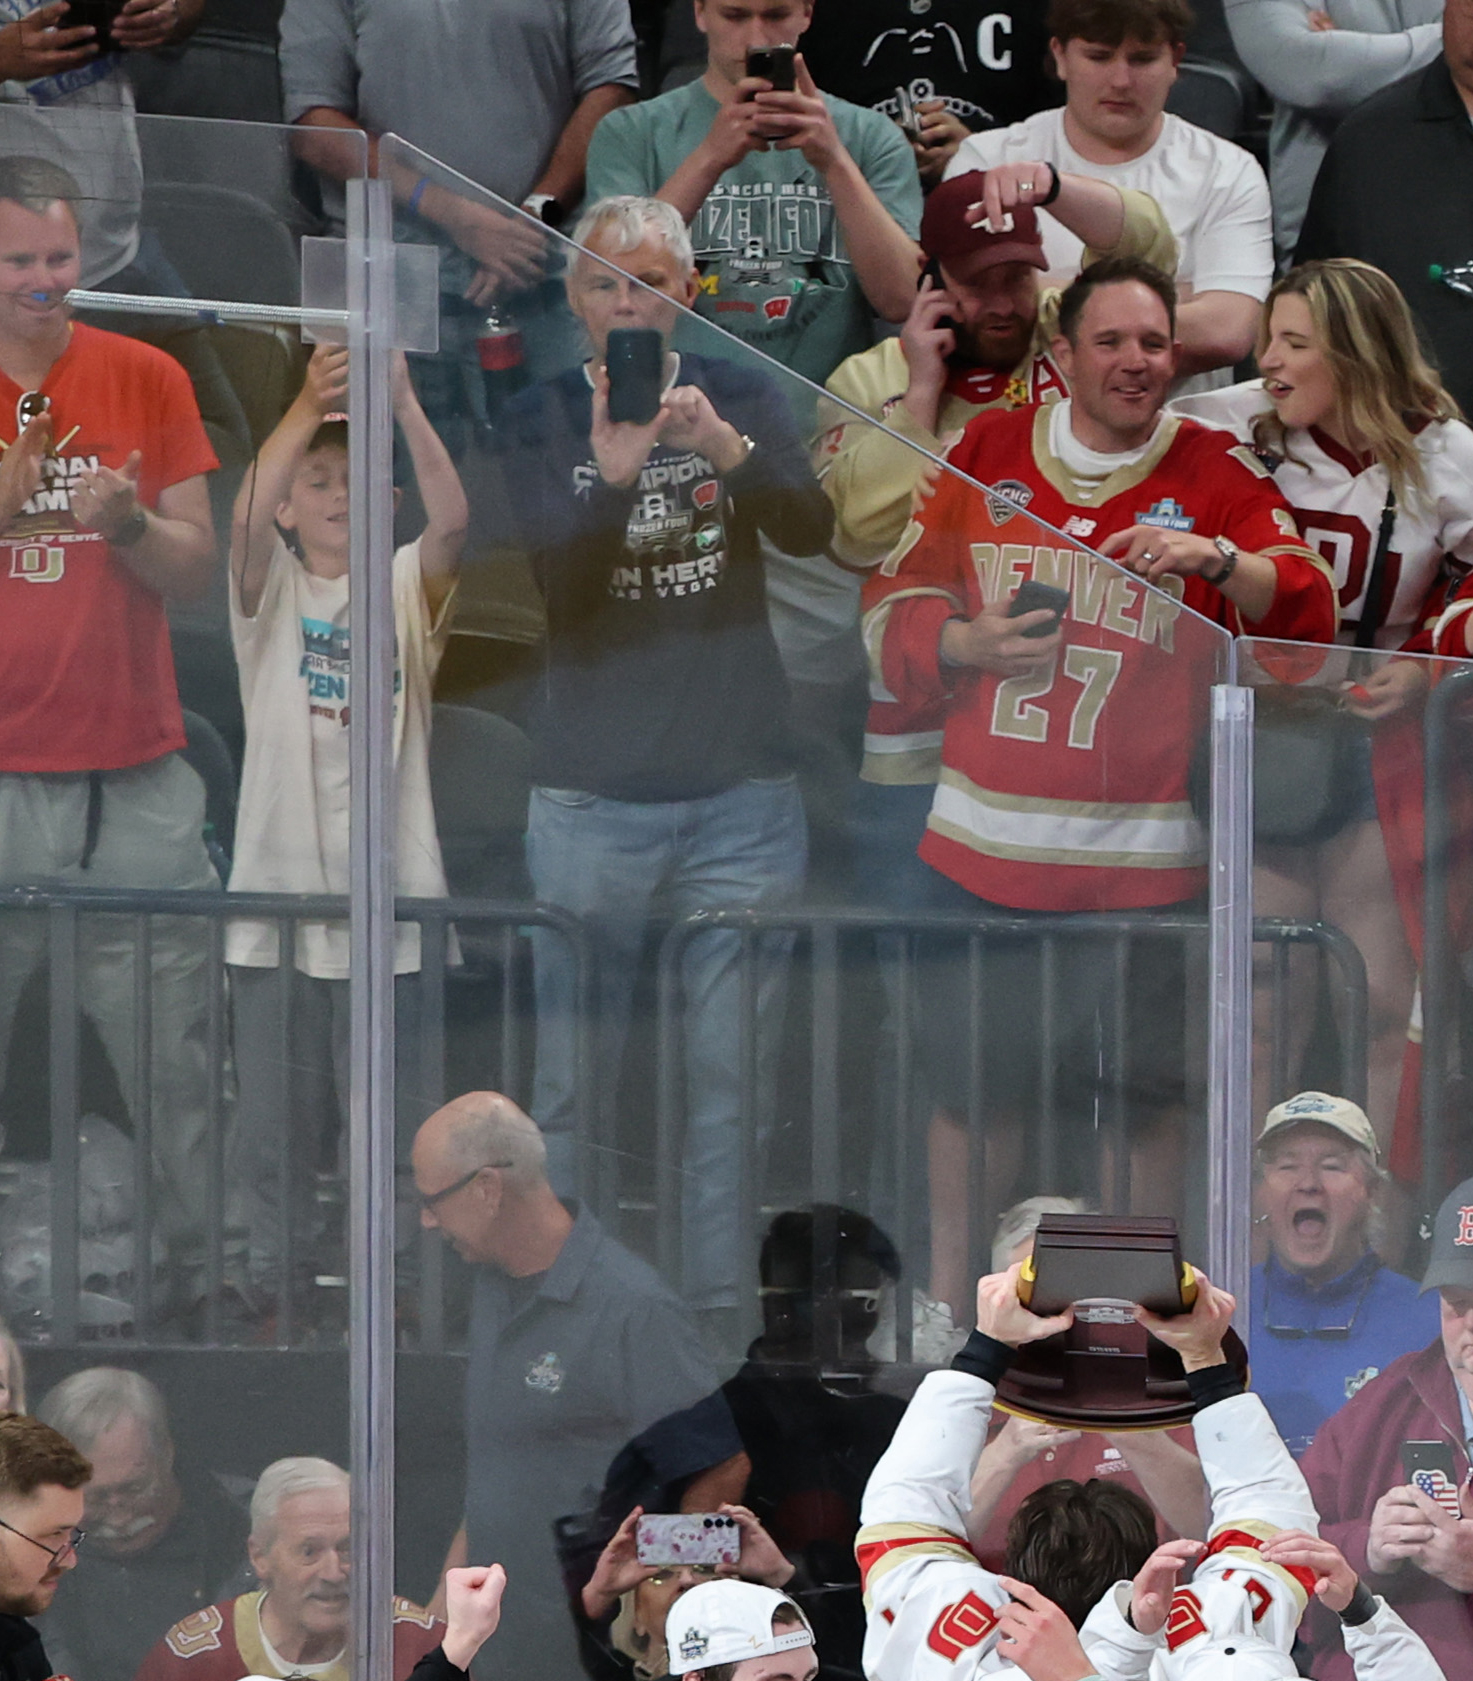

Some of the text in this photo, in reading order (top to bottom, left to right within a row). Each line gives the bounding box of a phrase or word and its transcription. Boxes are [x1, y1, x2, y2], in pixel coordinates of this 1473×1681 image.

[978, 13, 1012, 70] C
[1028, 352, 1071, 405] A
[990, 643, 1123, 751] 27
